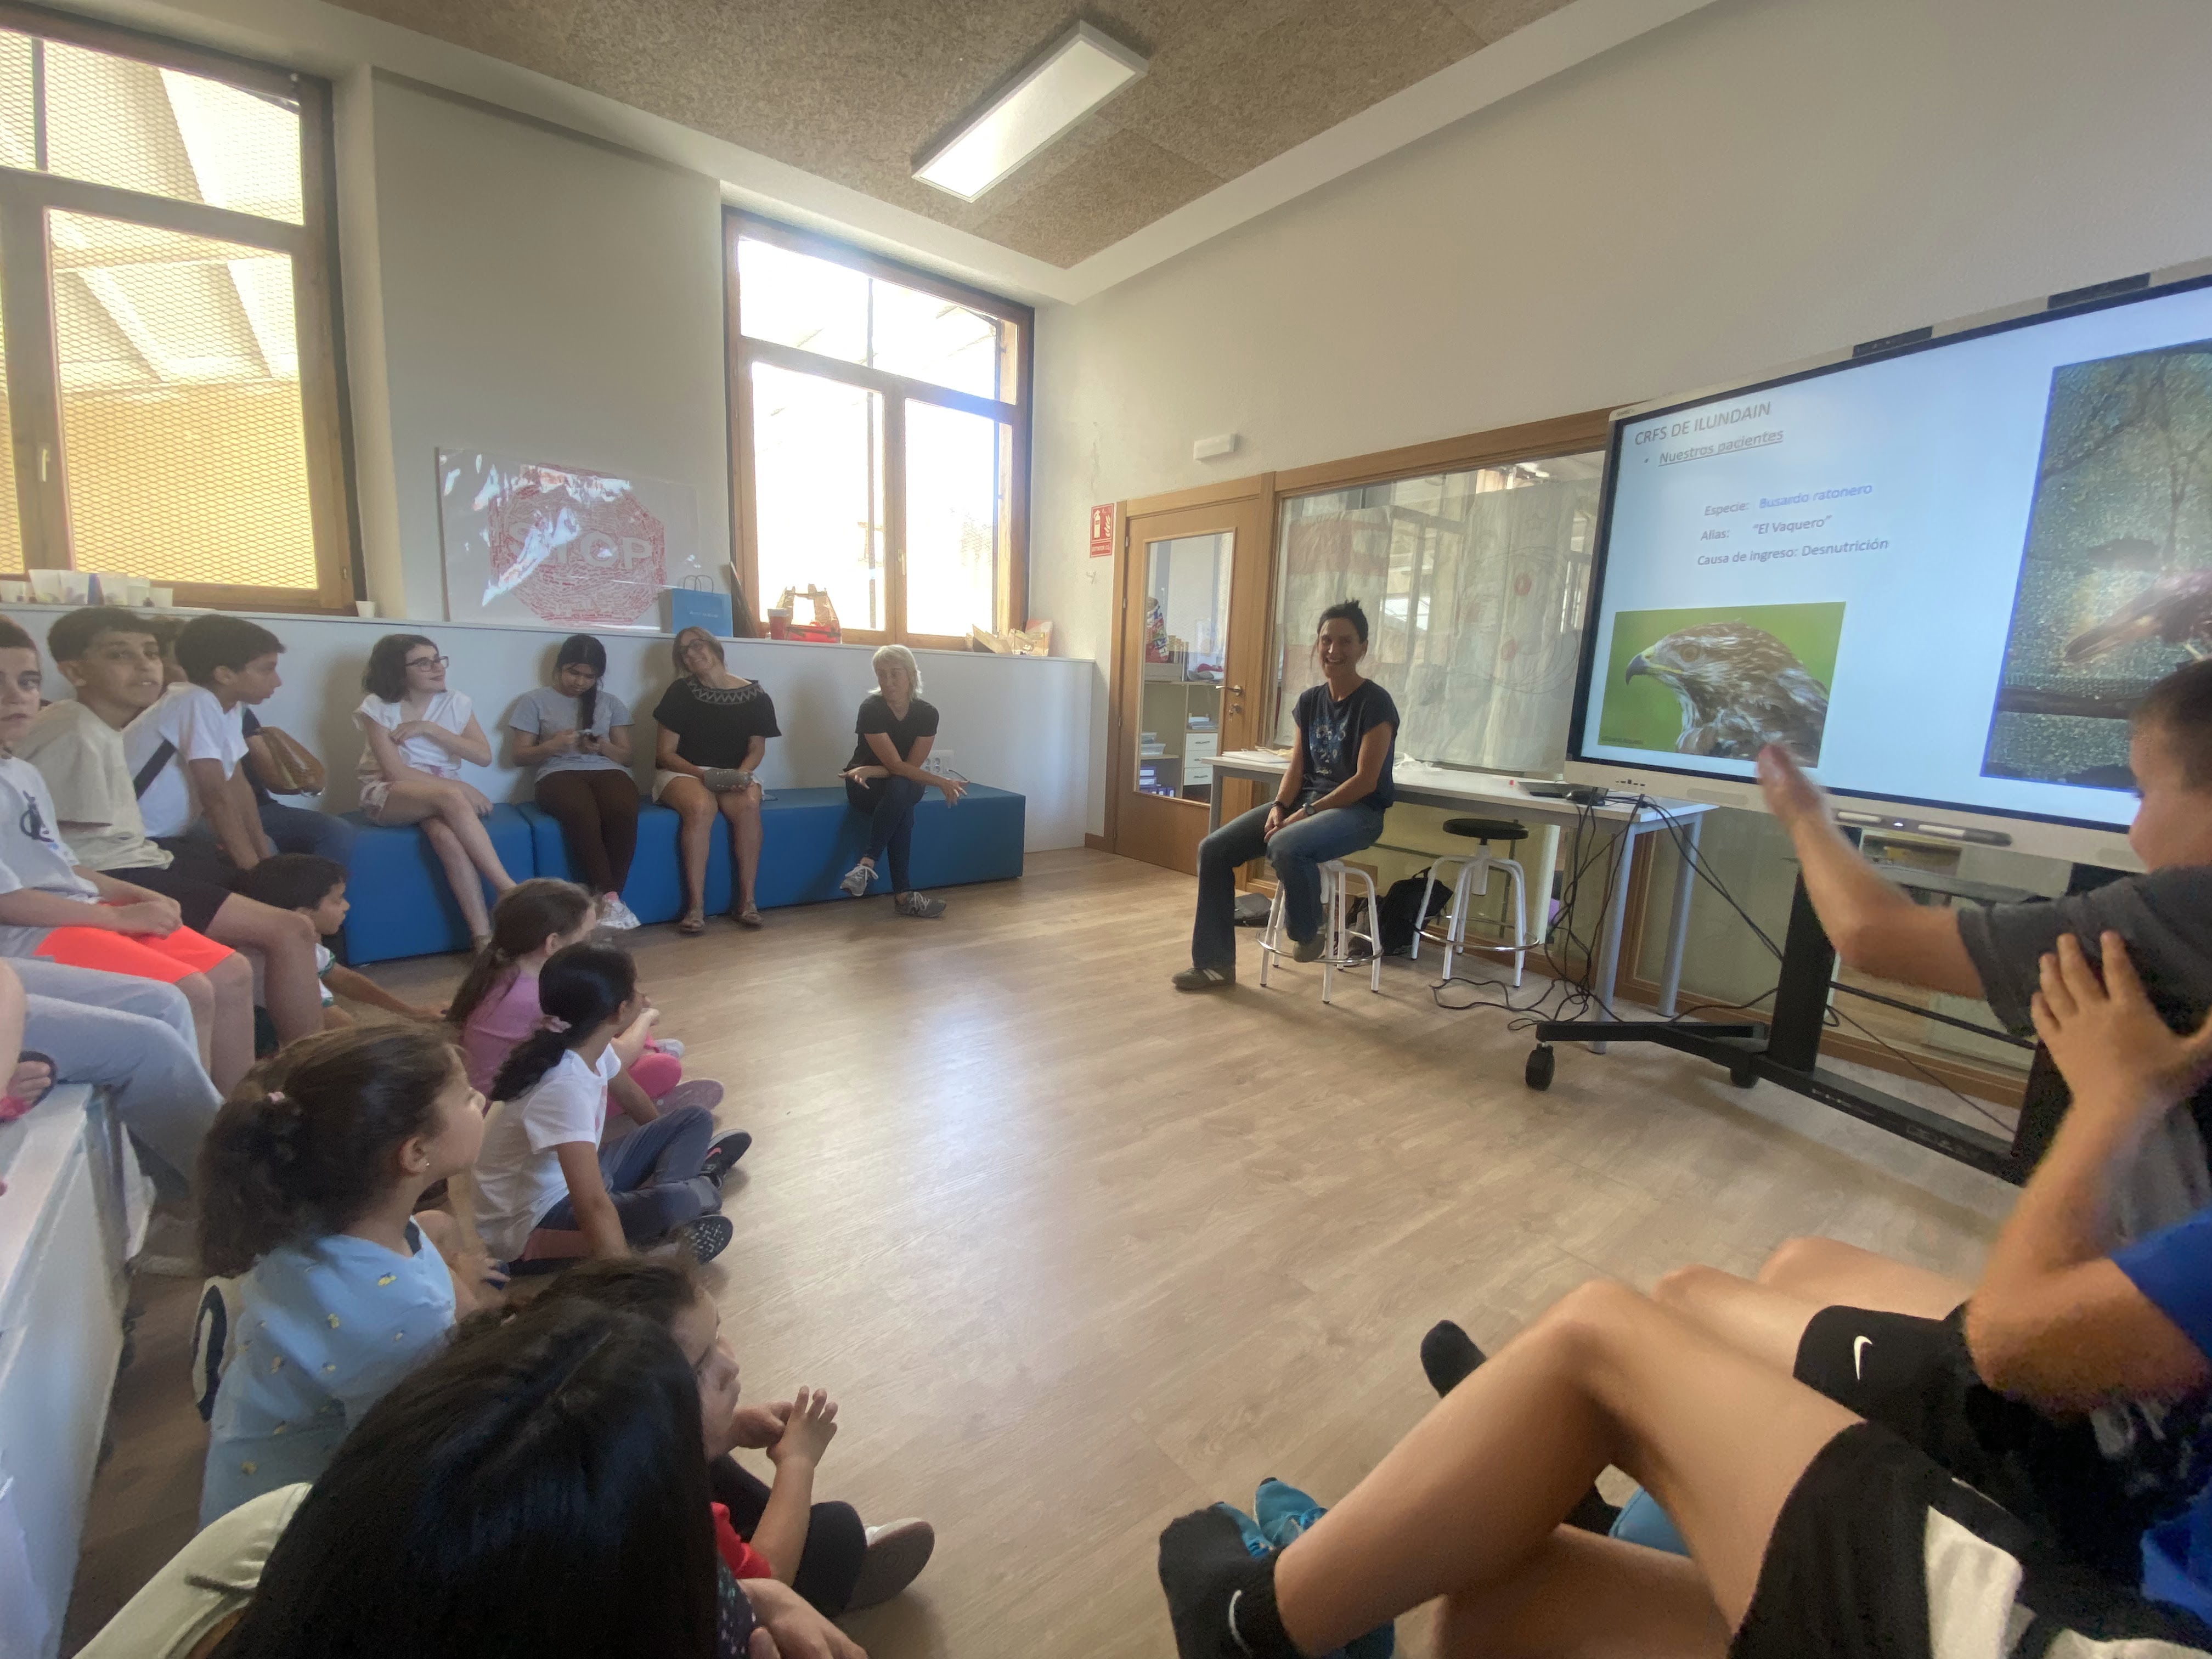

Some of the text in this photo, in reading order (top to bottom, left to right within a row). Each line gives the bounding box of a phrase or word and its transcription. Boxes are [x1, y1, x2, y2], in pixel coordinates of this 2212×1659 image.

[1635, 401, 1771, 445] CRFS DE ILUNDAIN
[1659, 430, 1784, 464] Nuestros pacientes
[1704, 485, 1872, 516] Especie: Busardo ratonero
[1700, 529, 1730, 541] Alias:
[1697, 555, 1729, 565] Causa
[1732, 551, 1747, 562] de
[1802, 538, 1889, 556] Desnutrición
